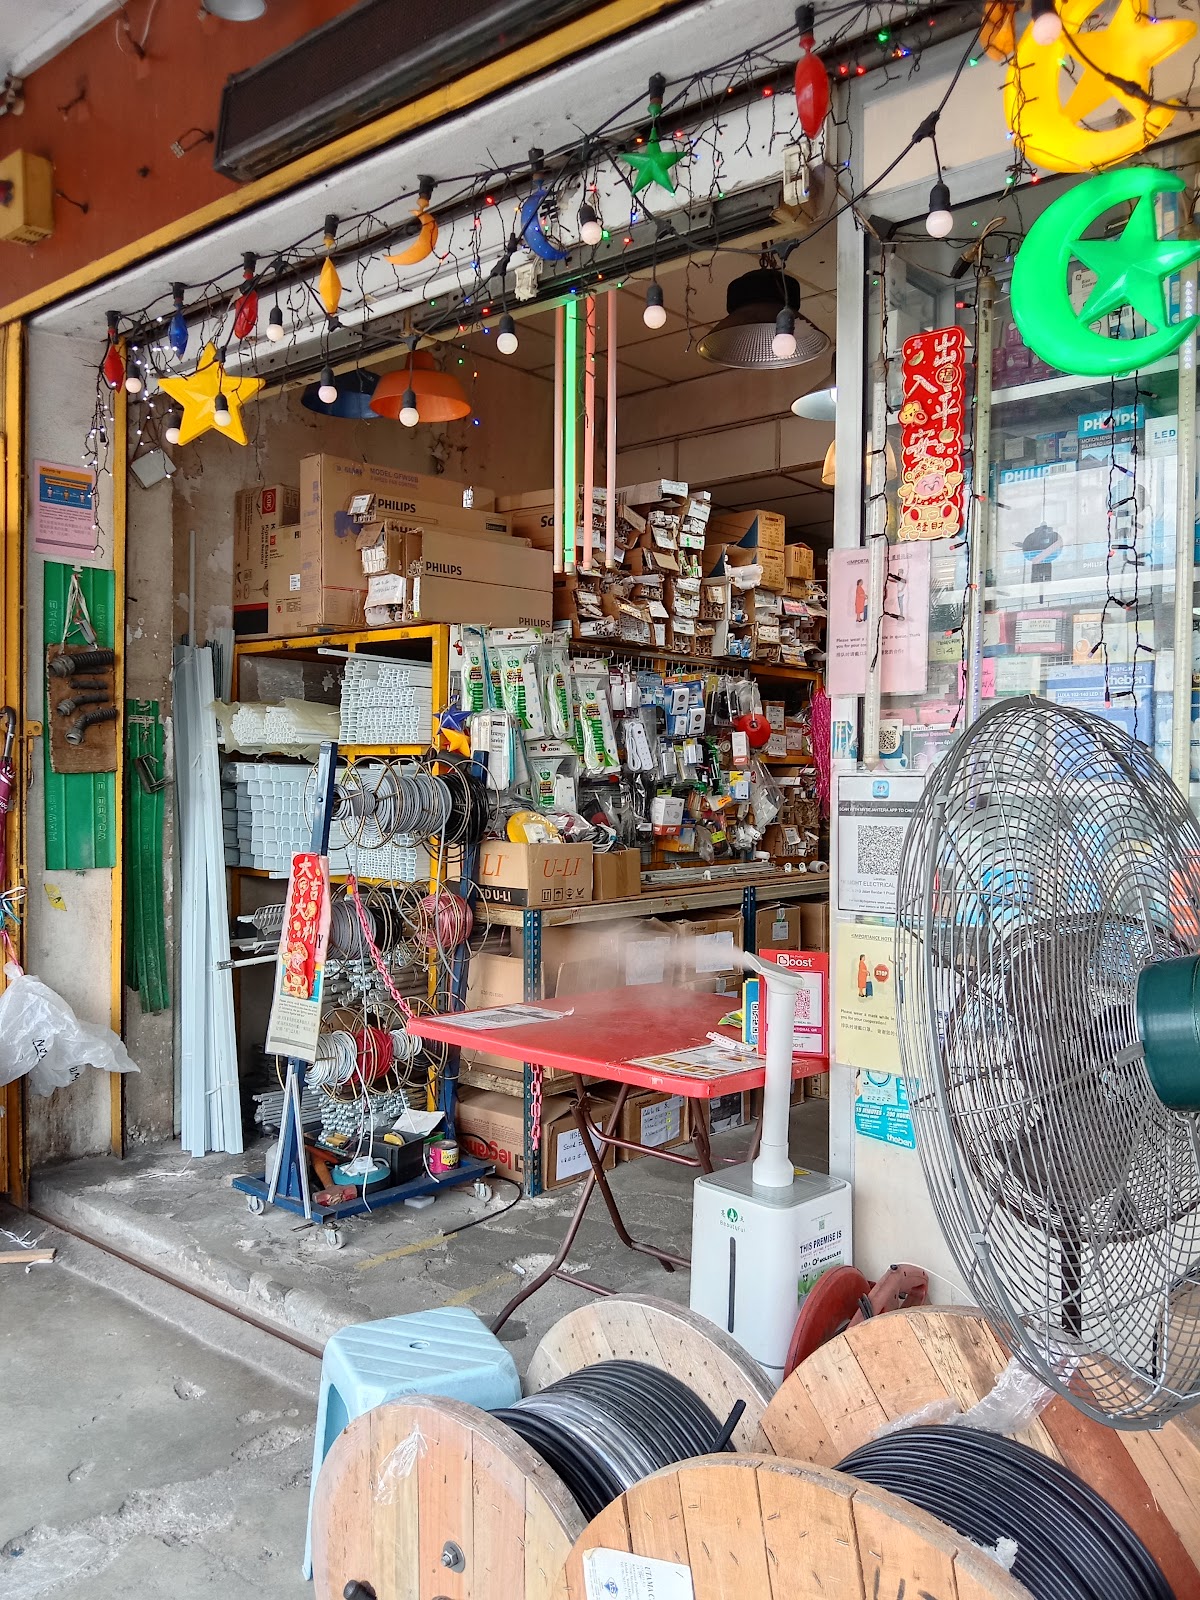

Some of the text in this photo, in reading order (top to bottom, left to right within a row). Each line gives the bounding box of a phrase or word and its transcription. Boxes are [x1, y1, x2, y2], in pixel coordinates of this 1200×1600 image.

[1083, 411, 1139, 431] PHIPS
[1154, 429, 1176, 440] LED
[370, 467, 393, 478] MODEL
[1005, 468, 1050, 483] PHILIP
[266, 492, 274, 509] KDK
[378, 499, 416, 513] PHILIPS
[425, 561, 462, 576] PHILIPS
[518, 616, 550, 628] PHILIPS
[543, 857, 582, 878] U-LI
[493, 890, 511, 902] U-LI
[886, 1133, 913, 1147] theben
[800, 1230, 842, 1254] THIS PREMISE IS
